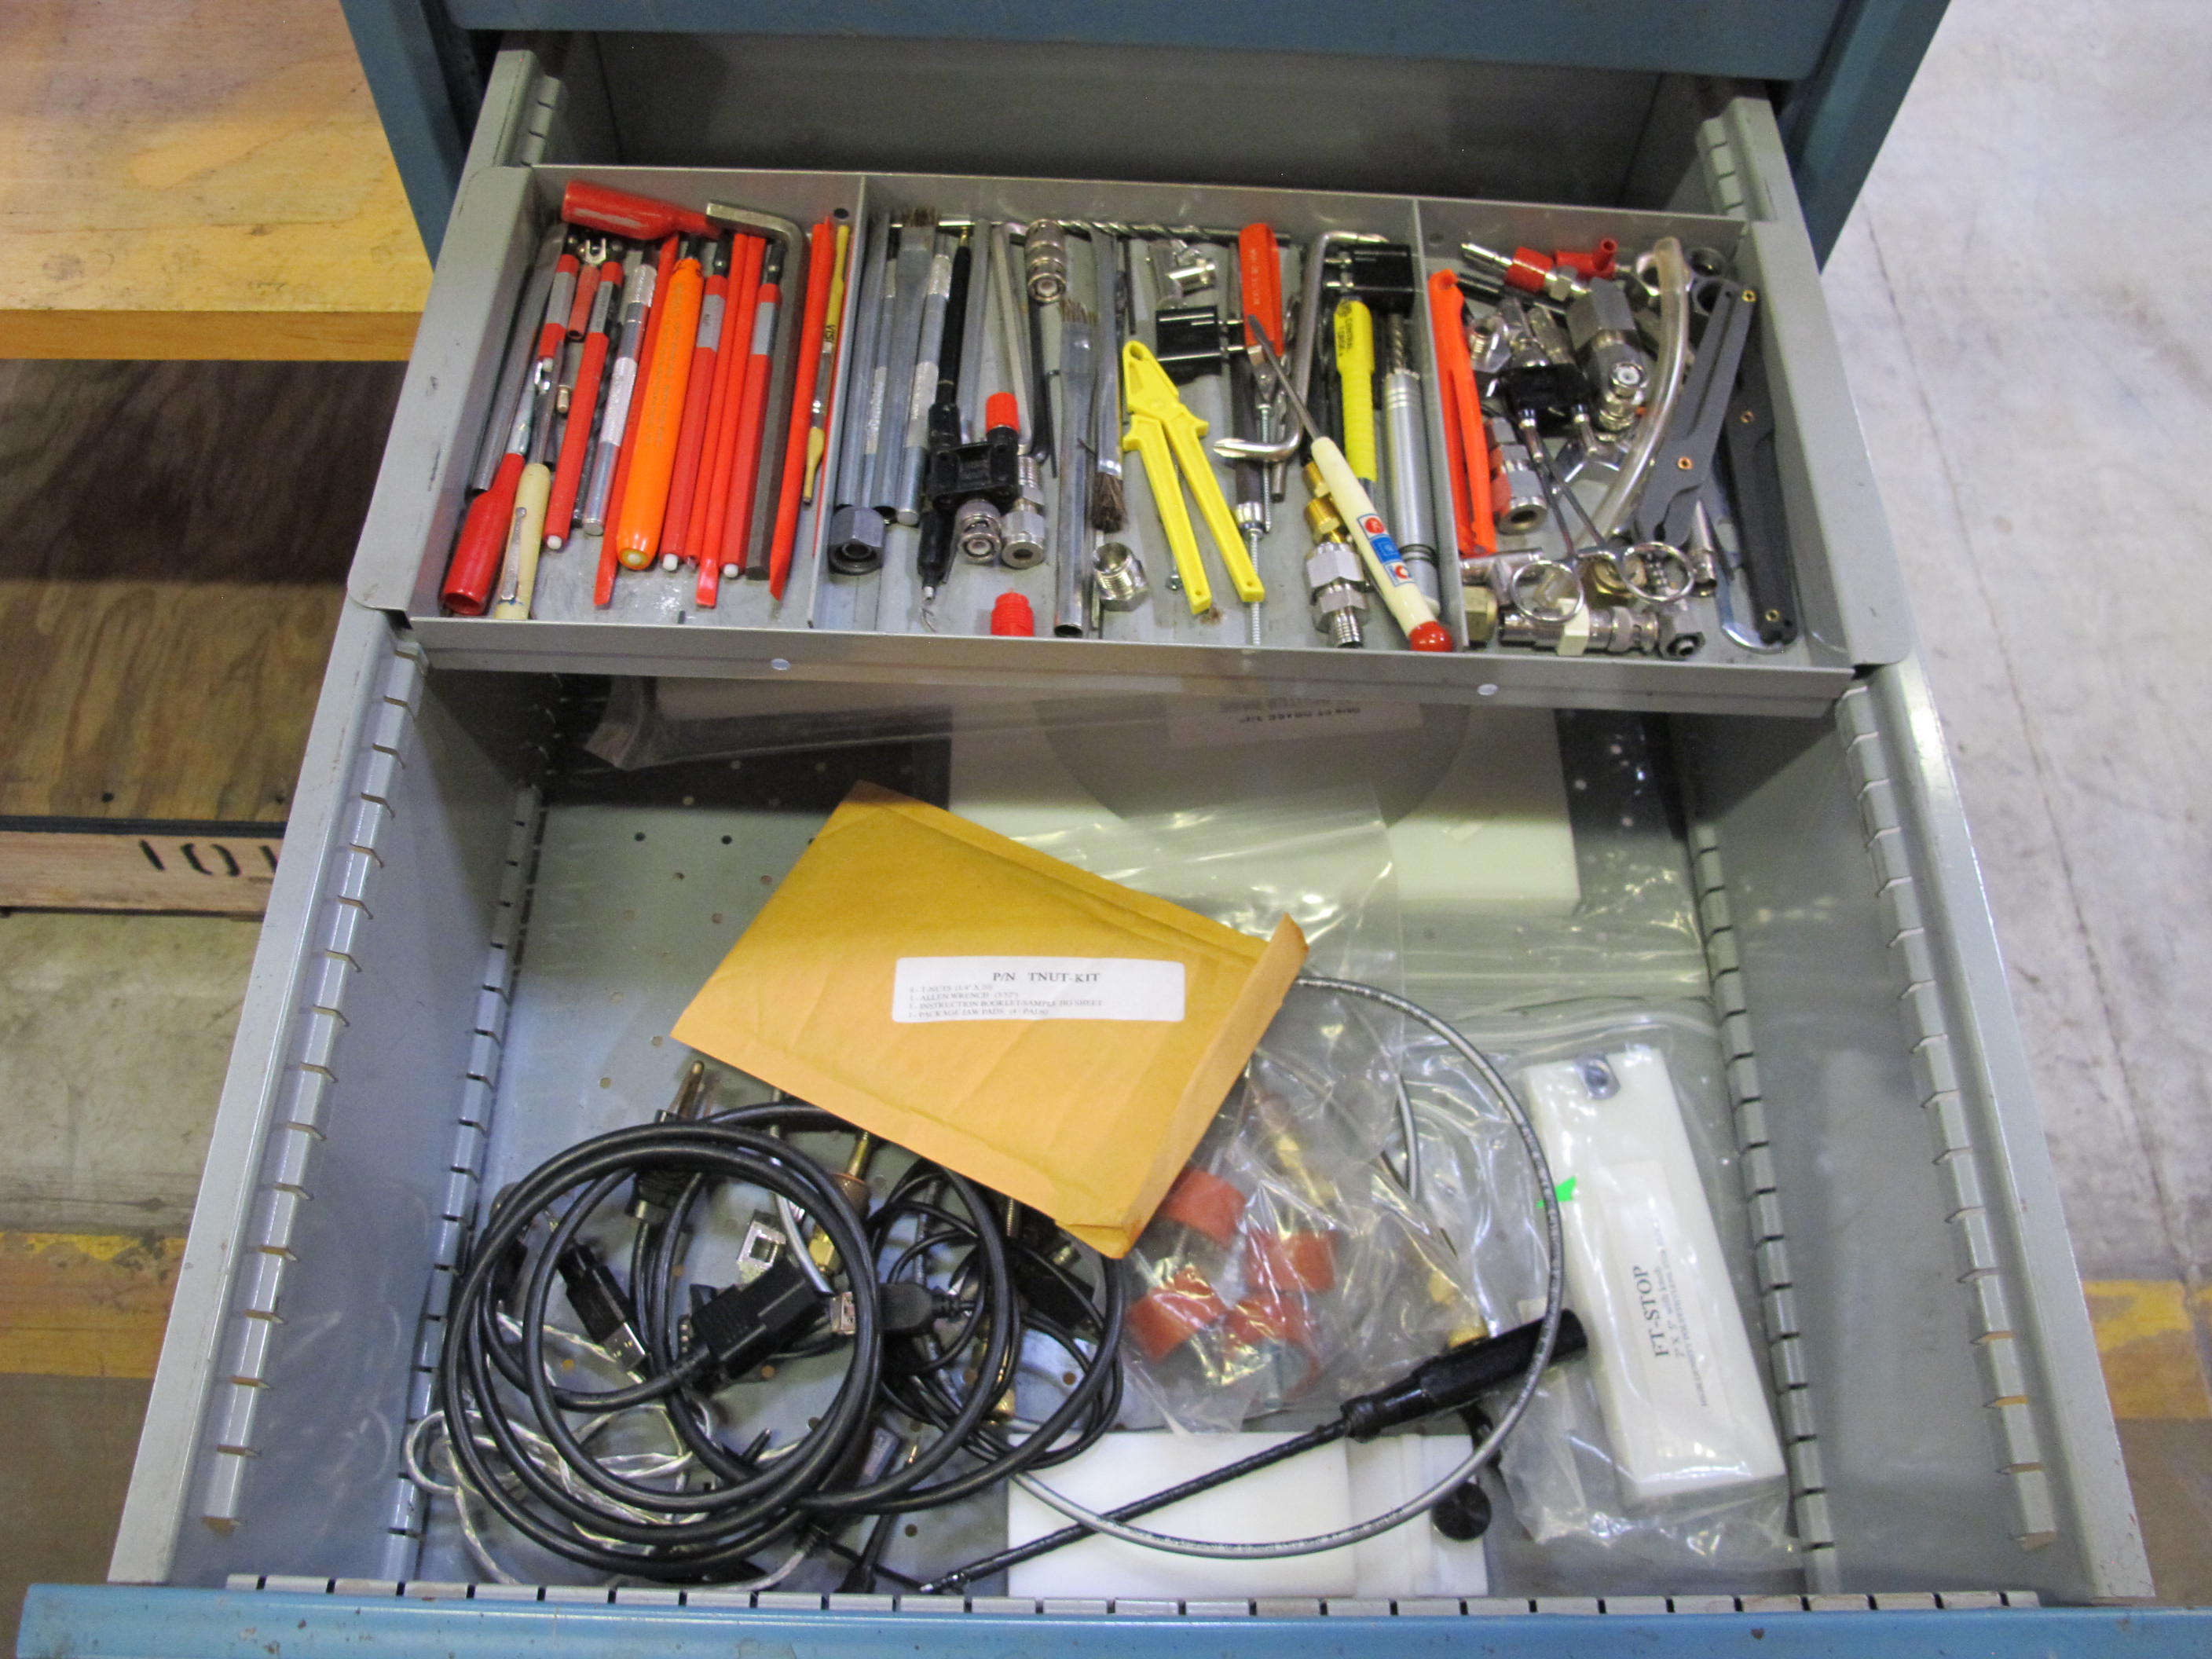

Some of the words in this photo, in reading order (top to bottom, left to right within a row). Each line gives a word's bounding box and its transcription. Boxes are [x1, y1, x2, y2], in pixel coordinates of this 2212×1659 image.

[993, 972, 1016, 982] P/N
[1027, 972, 1101, 983] TNUT-KIT
[921, 992, 949, 1002] ALLEN
[950, 991, 990, 1000] WRENCH
[1633, 1265, 1669, 1357] FT-STOP
